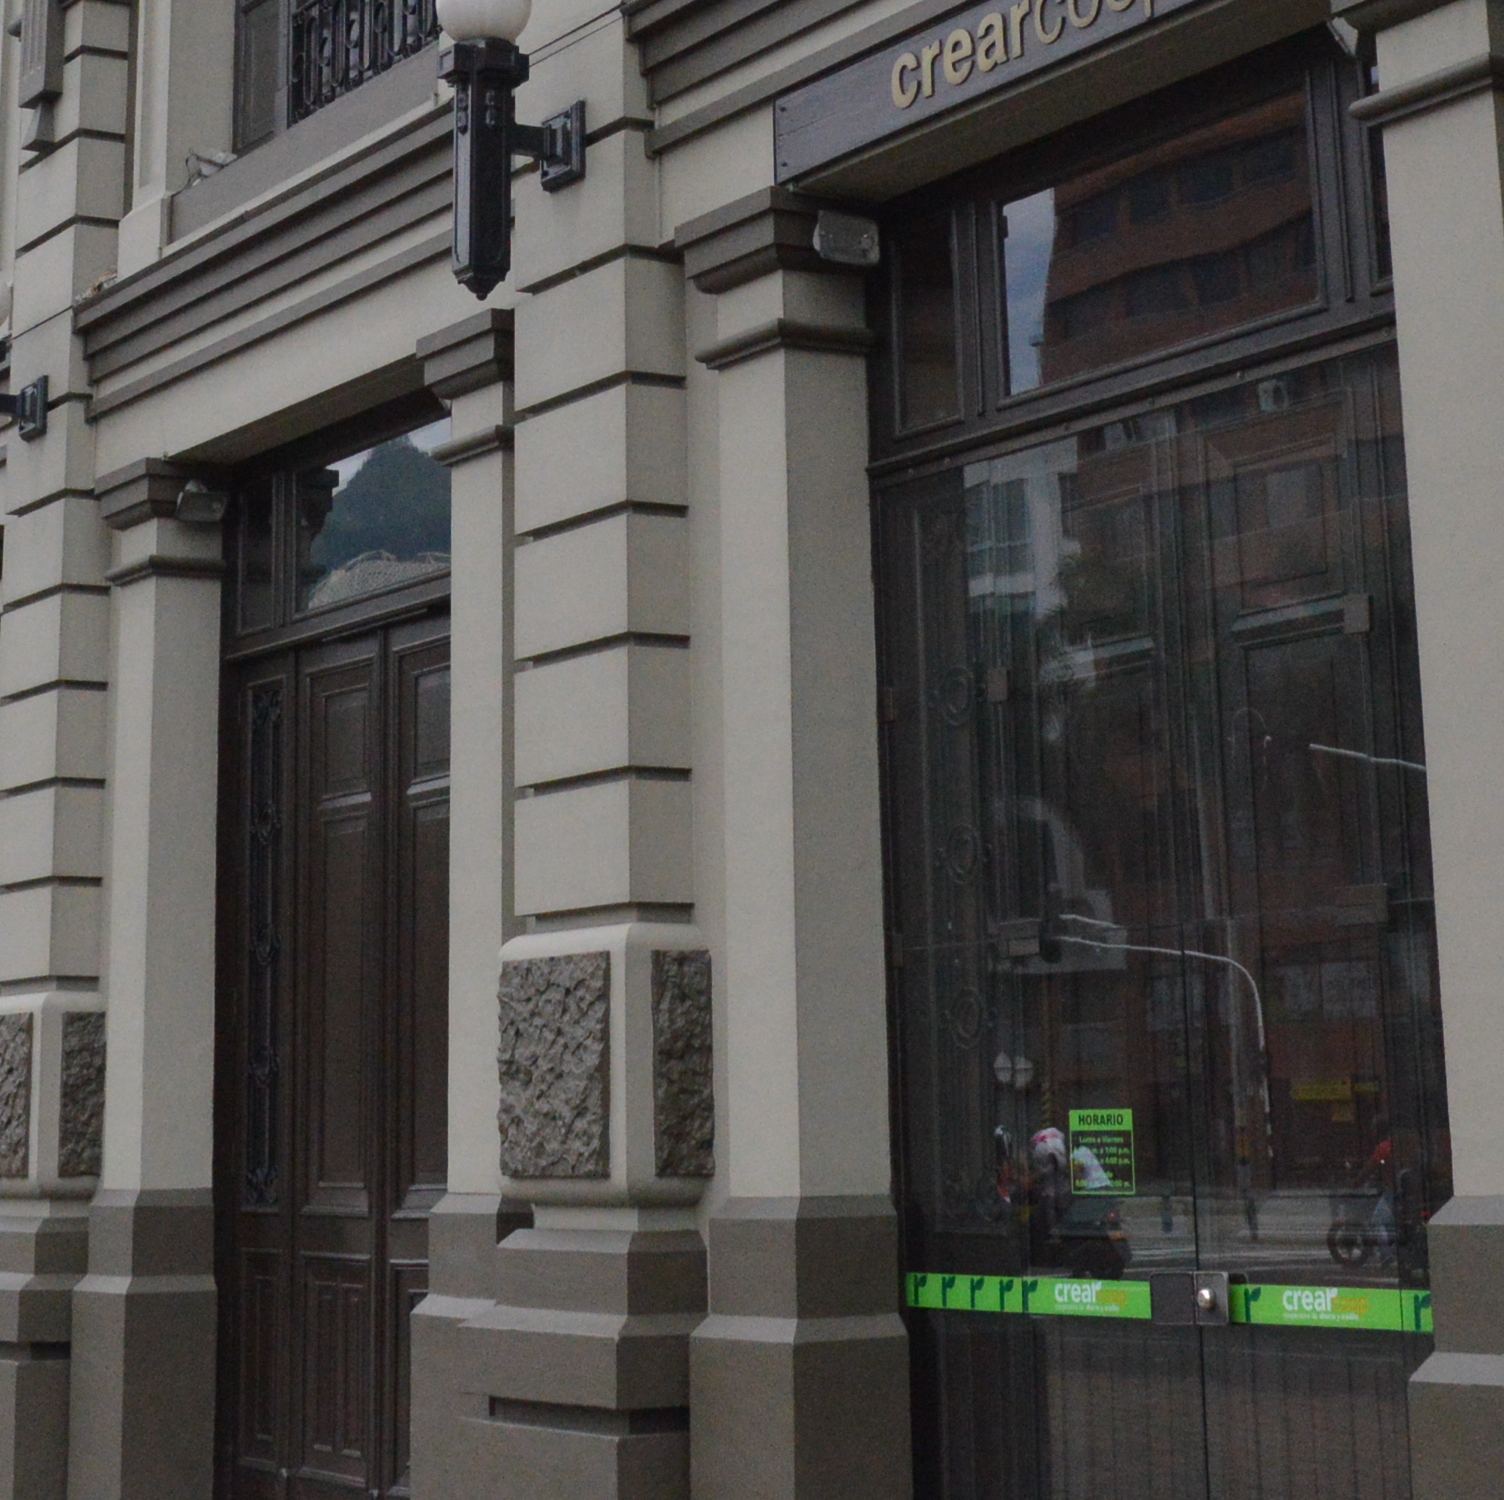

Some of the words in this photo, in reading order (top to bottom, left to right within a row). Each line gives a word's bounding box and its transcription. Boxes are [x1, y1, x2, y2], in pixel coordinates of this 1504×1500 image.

[1078, 1114, 1124, 1125] HORARIO
[1102, 1136, 1124, 1144] Viernes
[1282, 1287, 1369, 1317] crearcoop
